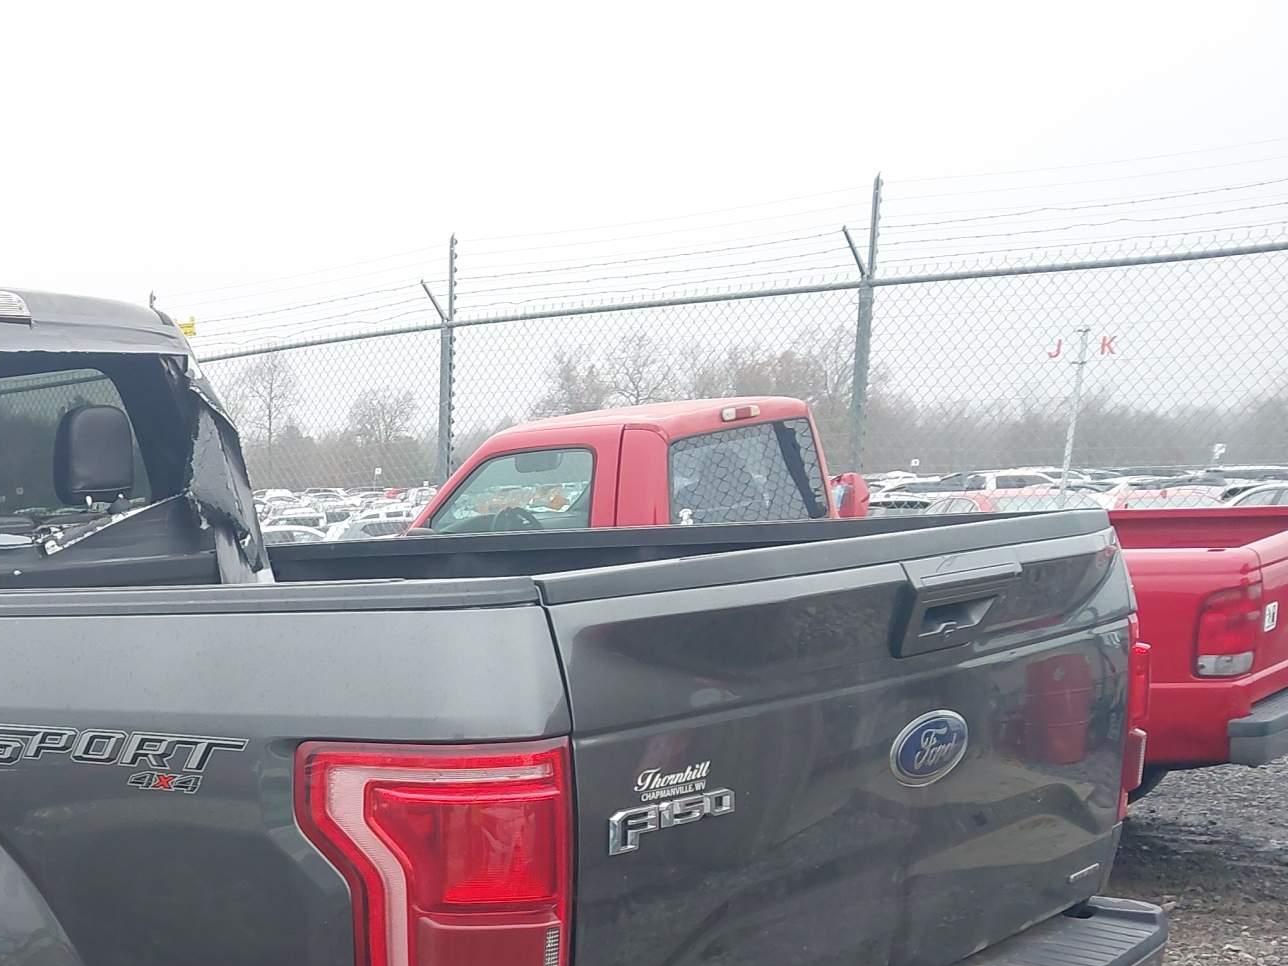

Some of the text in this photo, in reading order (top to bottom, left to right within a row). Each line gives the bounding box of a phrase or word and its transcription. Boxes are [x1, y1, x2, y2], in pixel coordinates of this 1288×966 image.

[1047, 335, 1118, 358] J K
[913, 726, 958, 770] Ford
[634, 760, 711, 792] Thornhill
[694, 779, 706, 791] WV
[608, 788, 736, 857] F150
